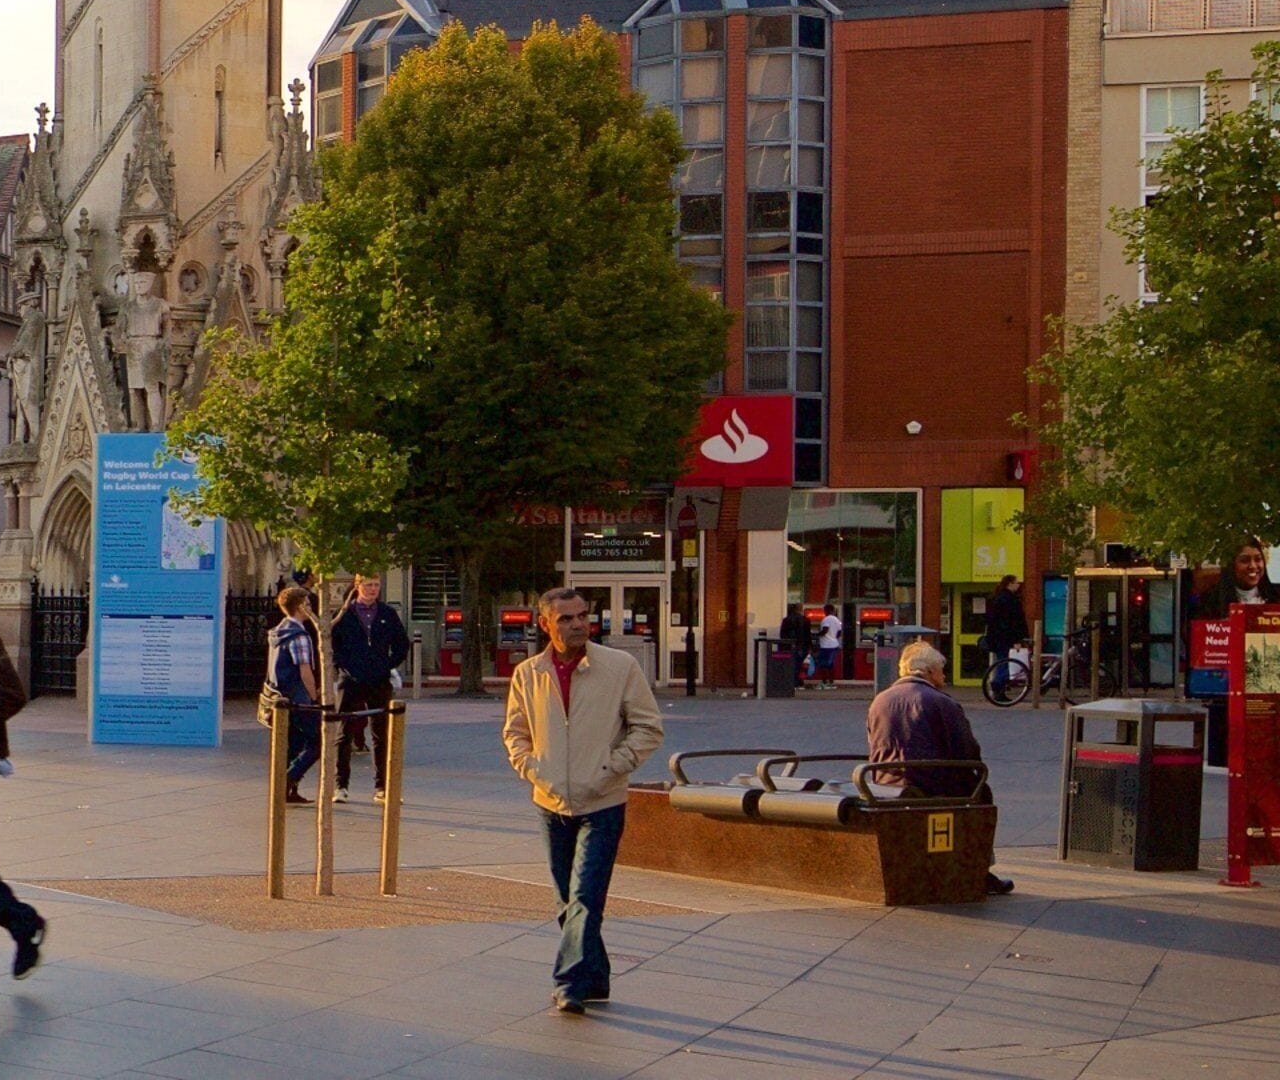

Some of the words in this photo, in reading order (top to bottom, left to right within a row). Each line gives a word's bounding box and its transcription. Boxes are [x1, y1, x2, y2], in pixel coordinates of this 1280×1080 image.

[103, 461, 150, 469] Welcome
[103, 472, 137, 481] Rugby
[139, 471, 169, 480] World
[171, 471, 190, 481] Cup
[103, 482, 113, 490] in
[115, 482, 162, 491] Leicester
[580, 537, 651, 547] santander.co.uk
[580, 549, 602, 557] 0845
[605, 549, 621, 557] 765
[623, 549, 644, 557] 4321
[1205, 636, 1229, 646] Need
